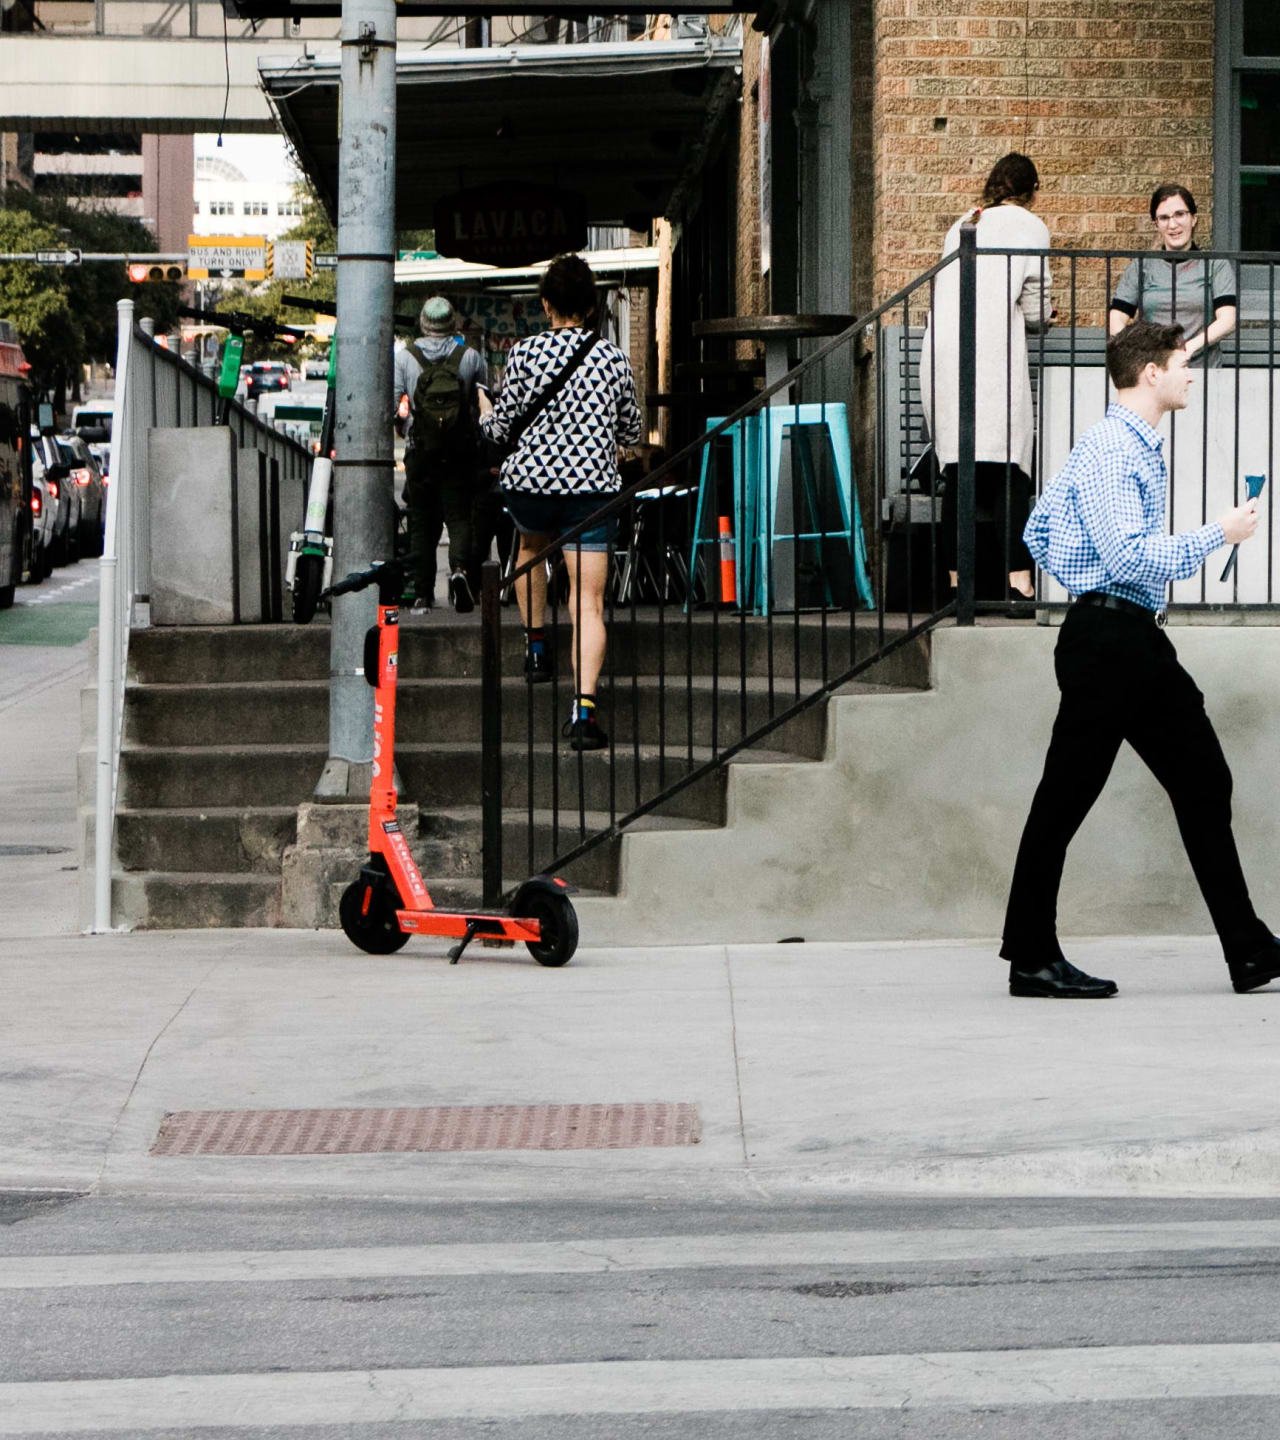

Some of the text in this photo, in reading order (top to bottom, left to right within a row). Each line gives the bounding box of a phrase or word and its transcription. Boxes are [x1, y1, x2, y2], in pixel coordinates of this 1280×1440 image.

[452, 208, 567, 241] LAVACA
[190, 248, 262, 256] BUS AND RIGHT
[199, 257, 255, 265] TURN ONLY
